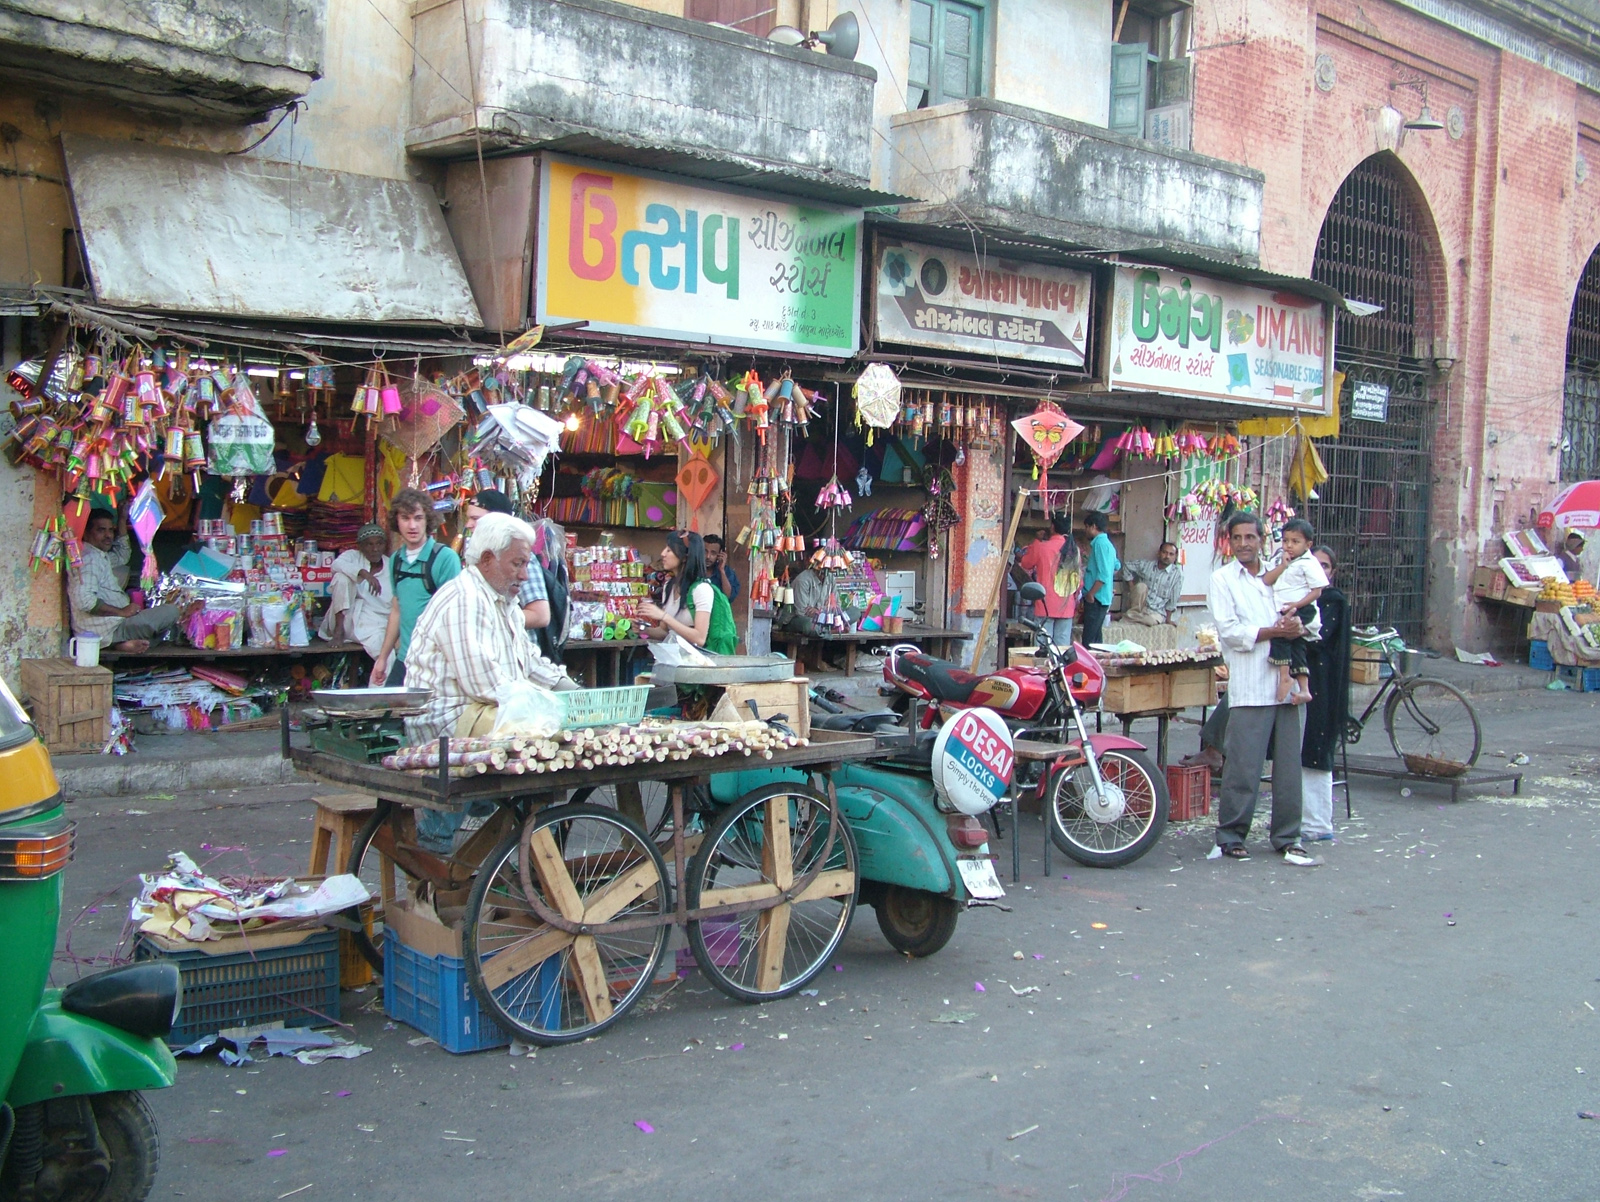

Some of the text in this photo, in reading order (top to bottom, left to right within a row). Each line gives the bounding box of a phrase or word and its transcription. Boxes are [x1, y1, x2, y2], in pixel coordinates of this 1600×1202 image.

[568, 172, 740, 300] ઉત્સવ
[1132, 270, 1223, 354] ઉમંગ
[1256, 304, 1324, 358] UMANG
[1254, 358, 1302, 382] SEASONABLE
[992, 685, 1013, 693] HONDA
[960, 716, 1013, 778] DESAI
[960, 750, 996, 788] LOCKS
[947, 760, 994, 806] Simply the best
